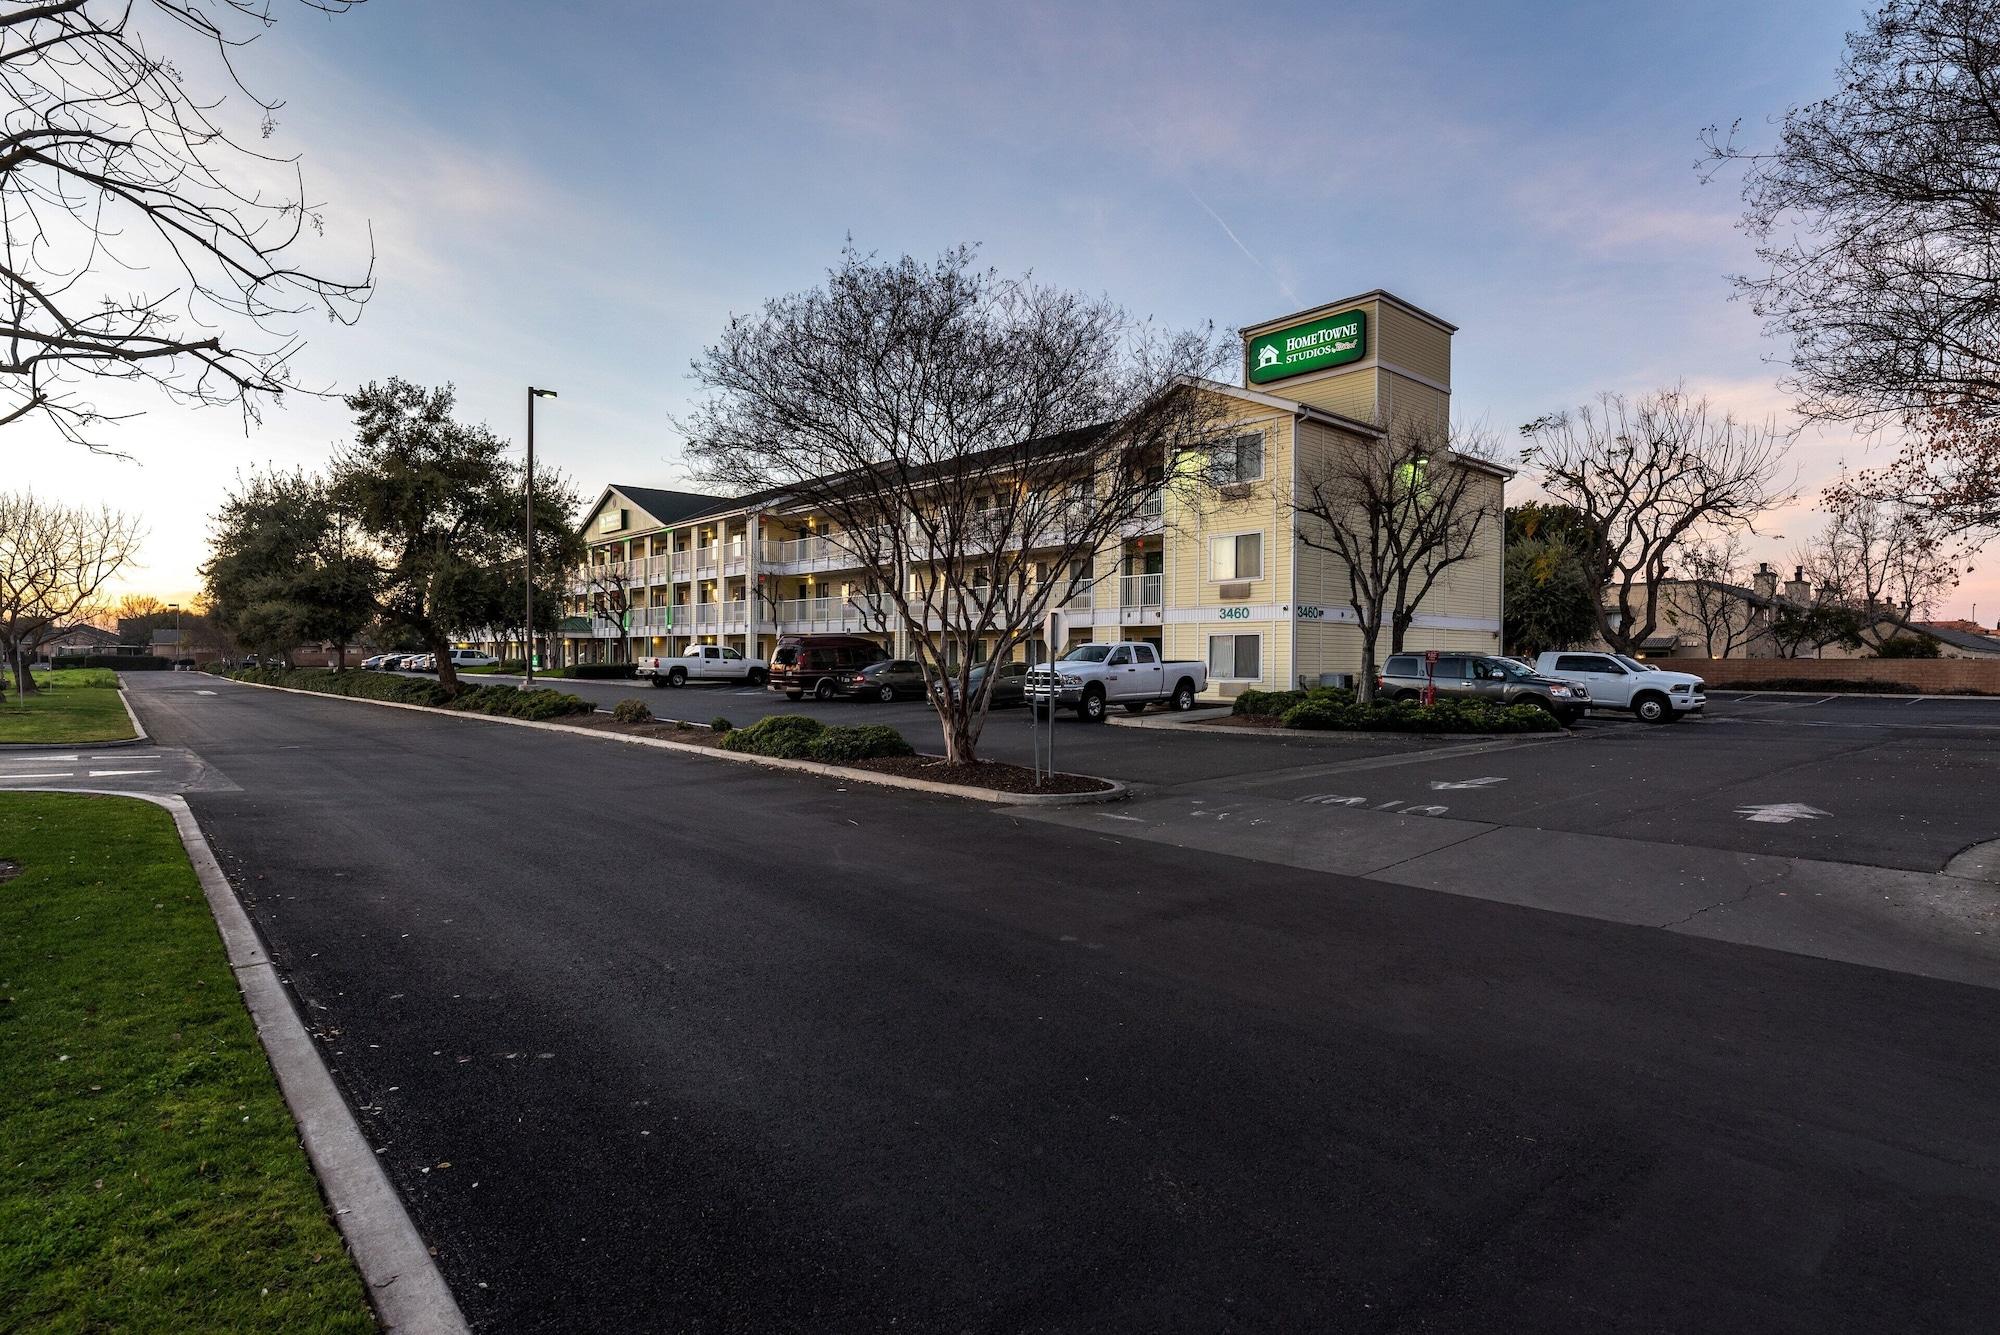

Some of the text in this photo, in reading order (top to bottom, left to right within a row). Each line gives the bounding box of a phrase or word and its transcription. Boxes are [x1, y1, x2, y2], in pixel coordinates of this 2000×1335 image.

[1286, 345, 1331, 363] STUDIOS
[1219, 607, 1250, 619] 3460
[1297, 606, 1318, 618] 3460
